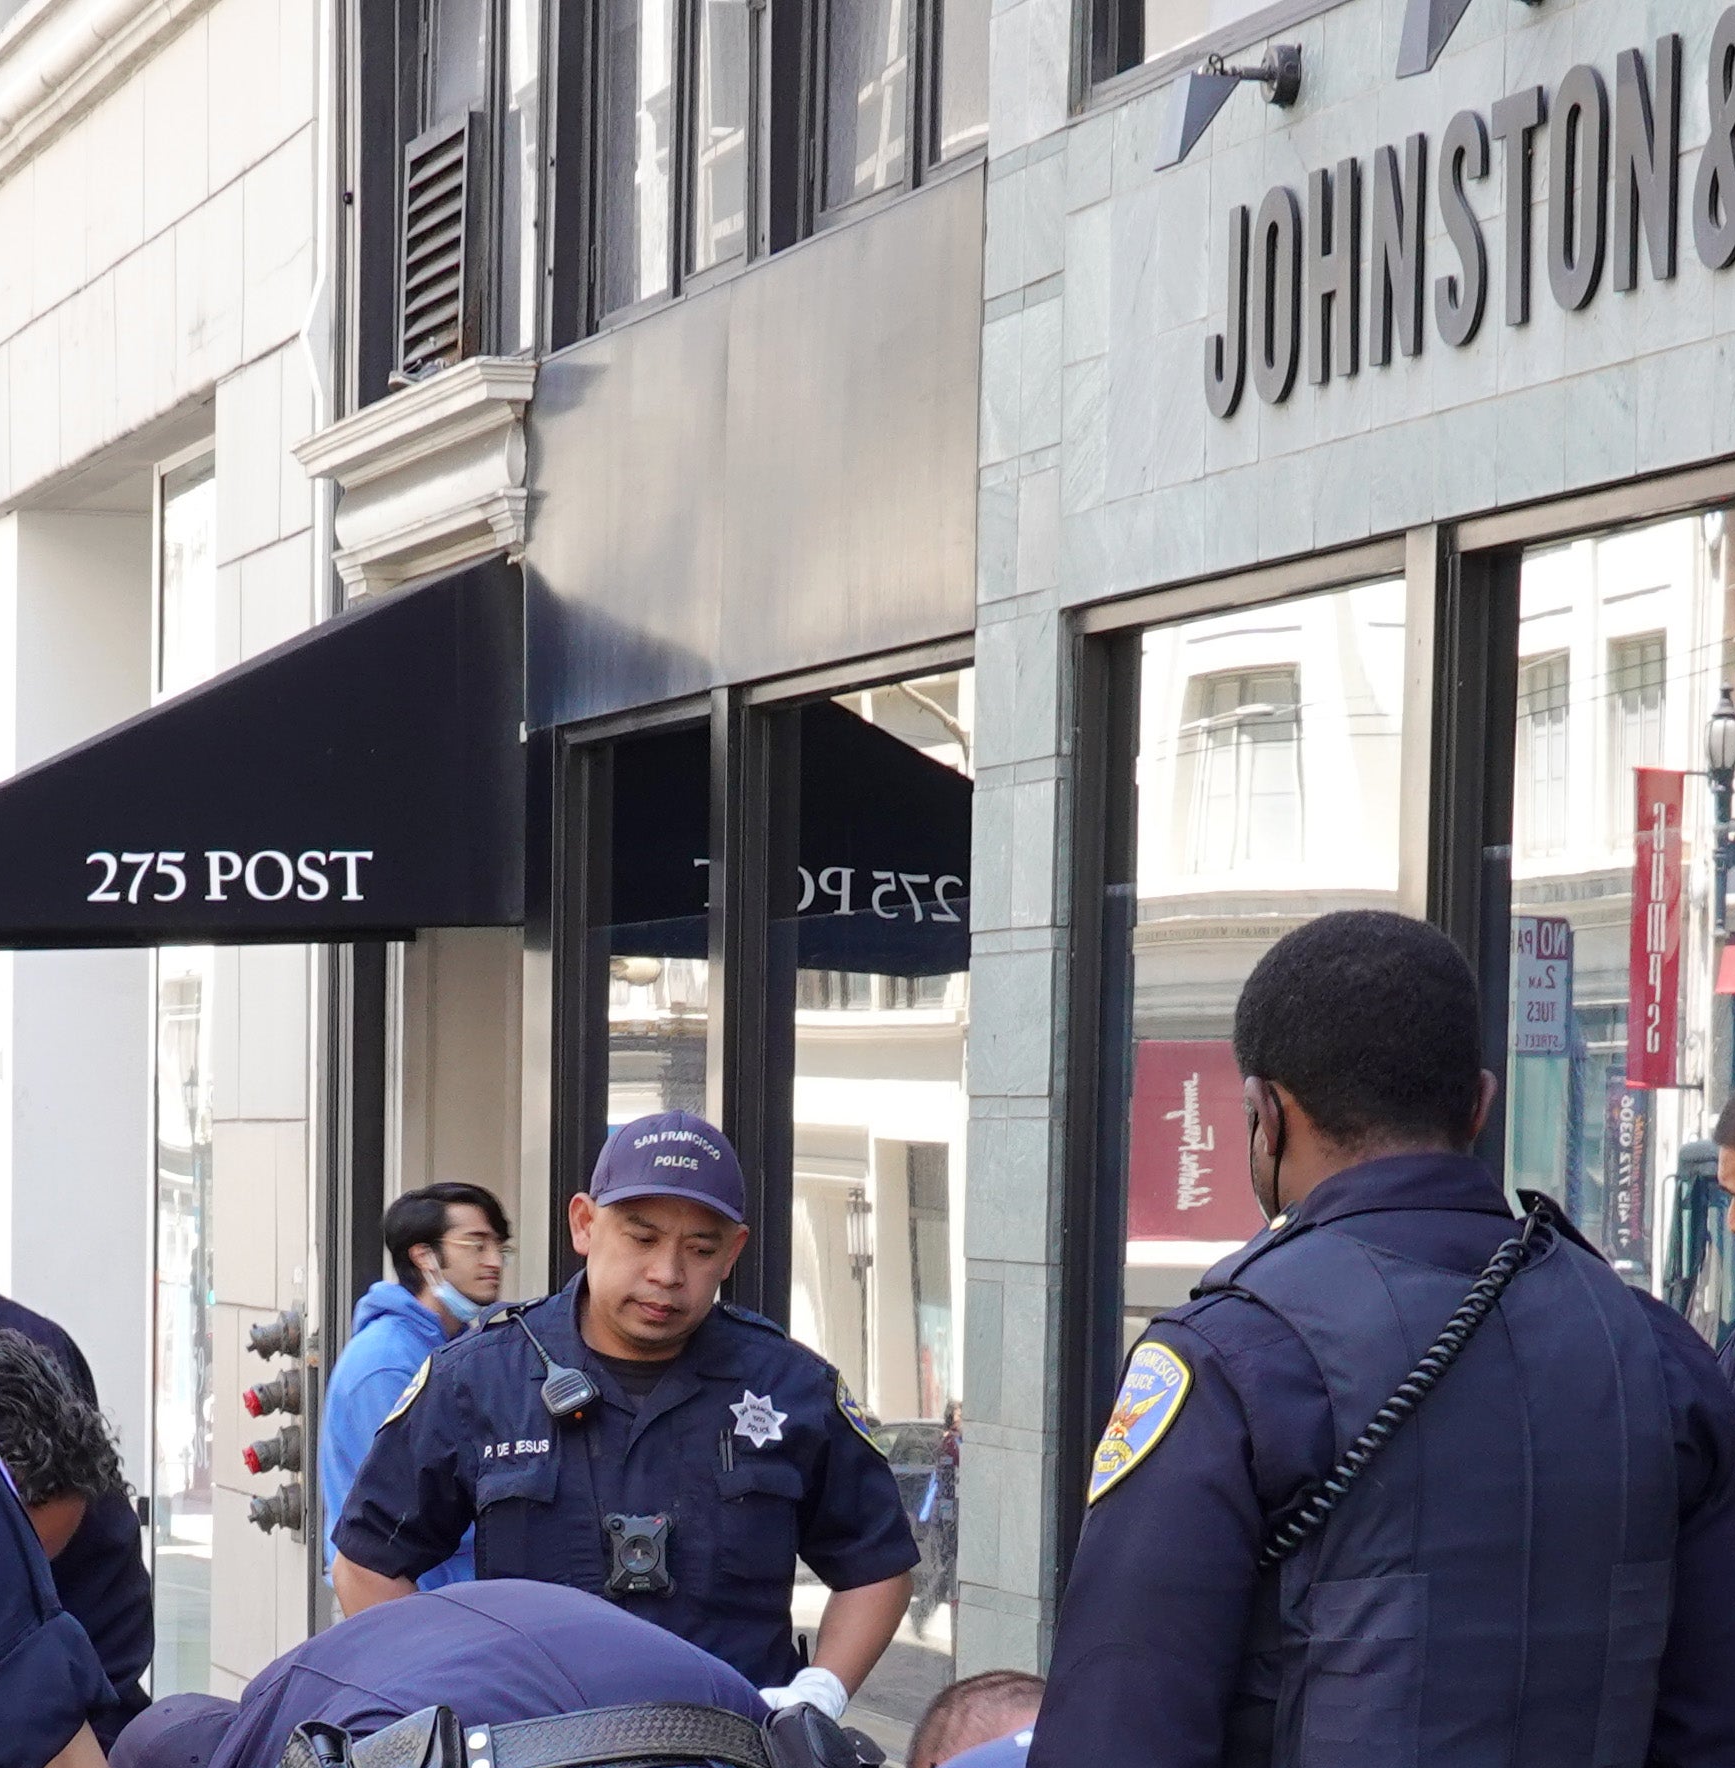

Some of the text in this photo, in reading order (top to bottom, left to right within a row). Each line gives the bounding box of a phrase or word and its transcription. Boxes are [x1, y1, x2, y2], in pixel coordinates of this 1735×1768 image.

[85, 850, 374, 905] 275 POST
[633, 1130, 721, 1160] SAN FRANCISCO
[653, 1155, 699, 1170] POLICE
